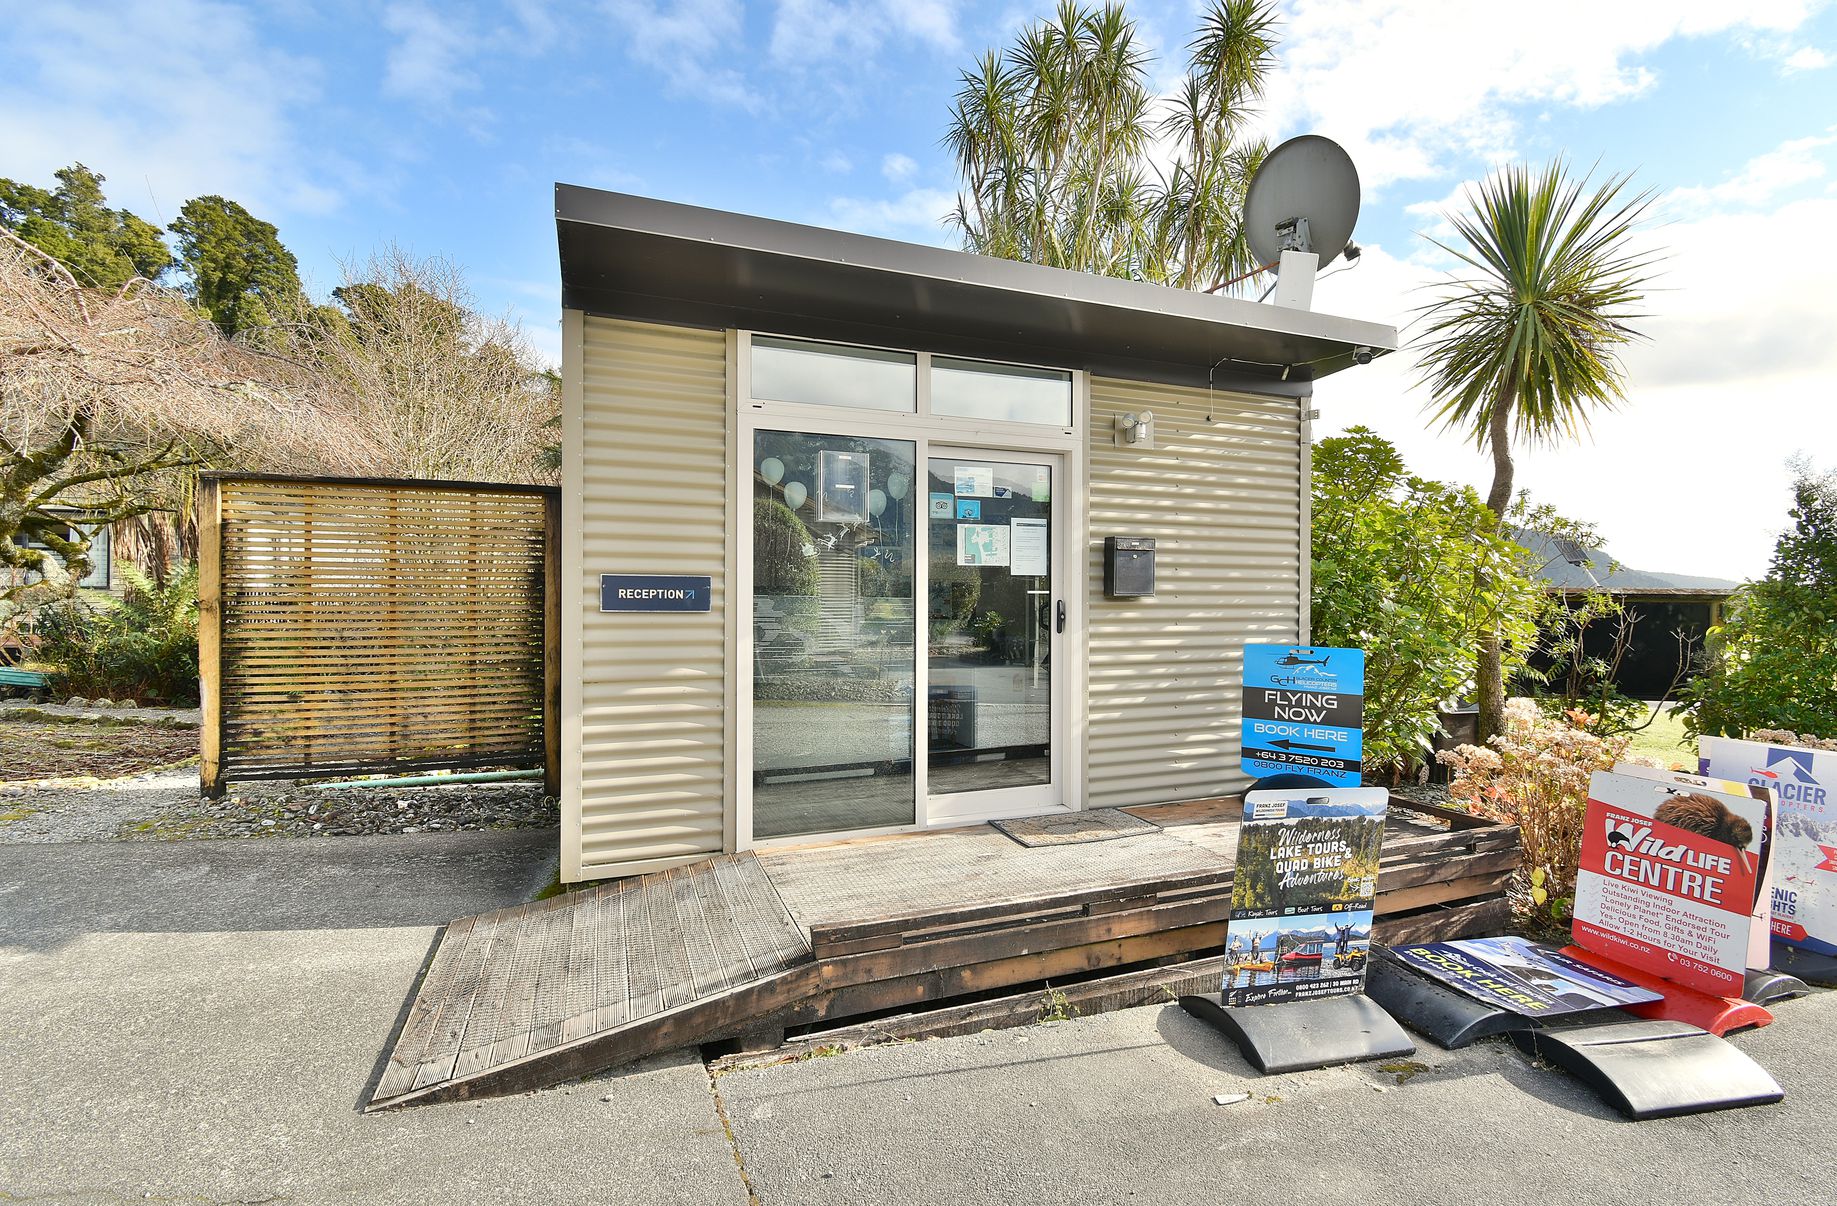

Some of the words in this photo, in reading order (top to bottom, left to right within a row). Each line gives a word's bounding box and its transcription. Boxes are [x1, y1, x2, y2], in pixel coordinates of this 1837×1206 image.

[618, 589, 684, 599] RECEPTION
[1264, 690, 1338, 709] FLYING
[1274, 706, 1327, 723] NOW
[1254, 723, 1300, 737] BOOK
[1304, 727, 1348, 742] HERE
[1253, 760, 1283, 770] 0800
[1285, 764, 1305, 773] FLY
[1307, 767, 1347, 778] FRANZ
[1255, 751, 1276, 760] +64
[1279, 753, 1287, 761] 3
[1288, 754, 1318, 765] 7520
[1320, 758, 1345, 769] 203
[1605, 812, 1631, 822] FRANZ
[1631, 816, 1654, 827] JOSEF
[1278, 827, 1341, 847] Wilderness
[1270, 845, 1303, 860] LAKE
[1307, 840, 1347, 855] TOURS
[1344, 847, 1353, 859] &
[1275, 859, 1309, 874] QUAD
[1313, 855, 1342, 869] BIKE
[1278, 868, 1344, 891] Adventures
[1604, 850, 1724, 905] CENTRE
[1603, 879, 1620, 889] Live
[1621, 883, 1639, 895] Kiwi
[1640, 890, 1673, 906] Viewing
[1602, 887, 1651, 909] Outstanding
[1652, 900, 1680, 915] Indoor
[1681, 911, 1727, 930] Attraction
[1771, 900, 1796, 915] HTS
[1600, 902, 1637, 920] Delicious
[1664, 922, 1685, 935] Gifts
[1686, 929, 1694, 938] &
[1696, 932, 1717, 945] WiFi
[1600, 910, 1617, 921] Yes-
[1618, 916, 1640, 930] Open
[1641, 924, 1662, 936] from
[1662, 930, 1694, 946] 8.30am
[1695, 941, 1719, 956] Daily
[1665, 914, 1708, 933] Endorsed
[1709, 928, 1731, 940] Tour
[1771, 920, 1793, 936] HERE
[1581, 925, 1651, 954] www.wildkiwi.co.nz
[1598, 918, 1621, 931] Allow
[1622, 926, 1635, 936] 1-2
[1636, 931, 1662, 945] Hours
[1663, 938, 1676, 949] for
[1678, 943, 1699, 957] Your
[1700, 951, 1721, 964] Visit
[1408, 948, 1482, 979] BOOK
[1476, 979, 1551, 1011] HERE
[1679, 957, 1691, 968] 03
[1692, 962, 1709, 974] 752
[1710, 967, 1733, 982] 0600
